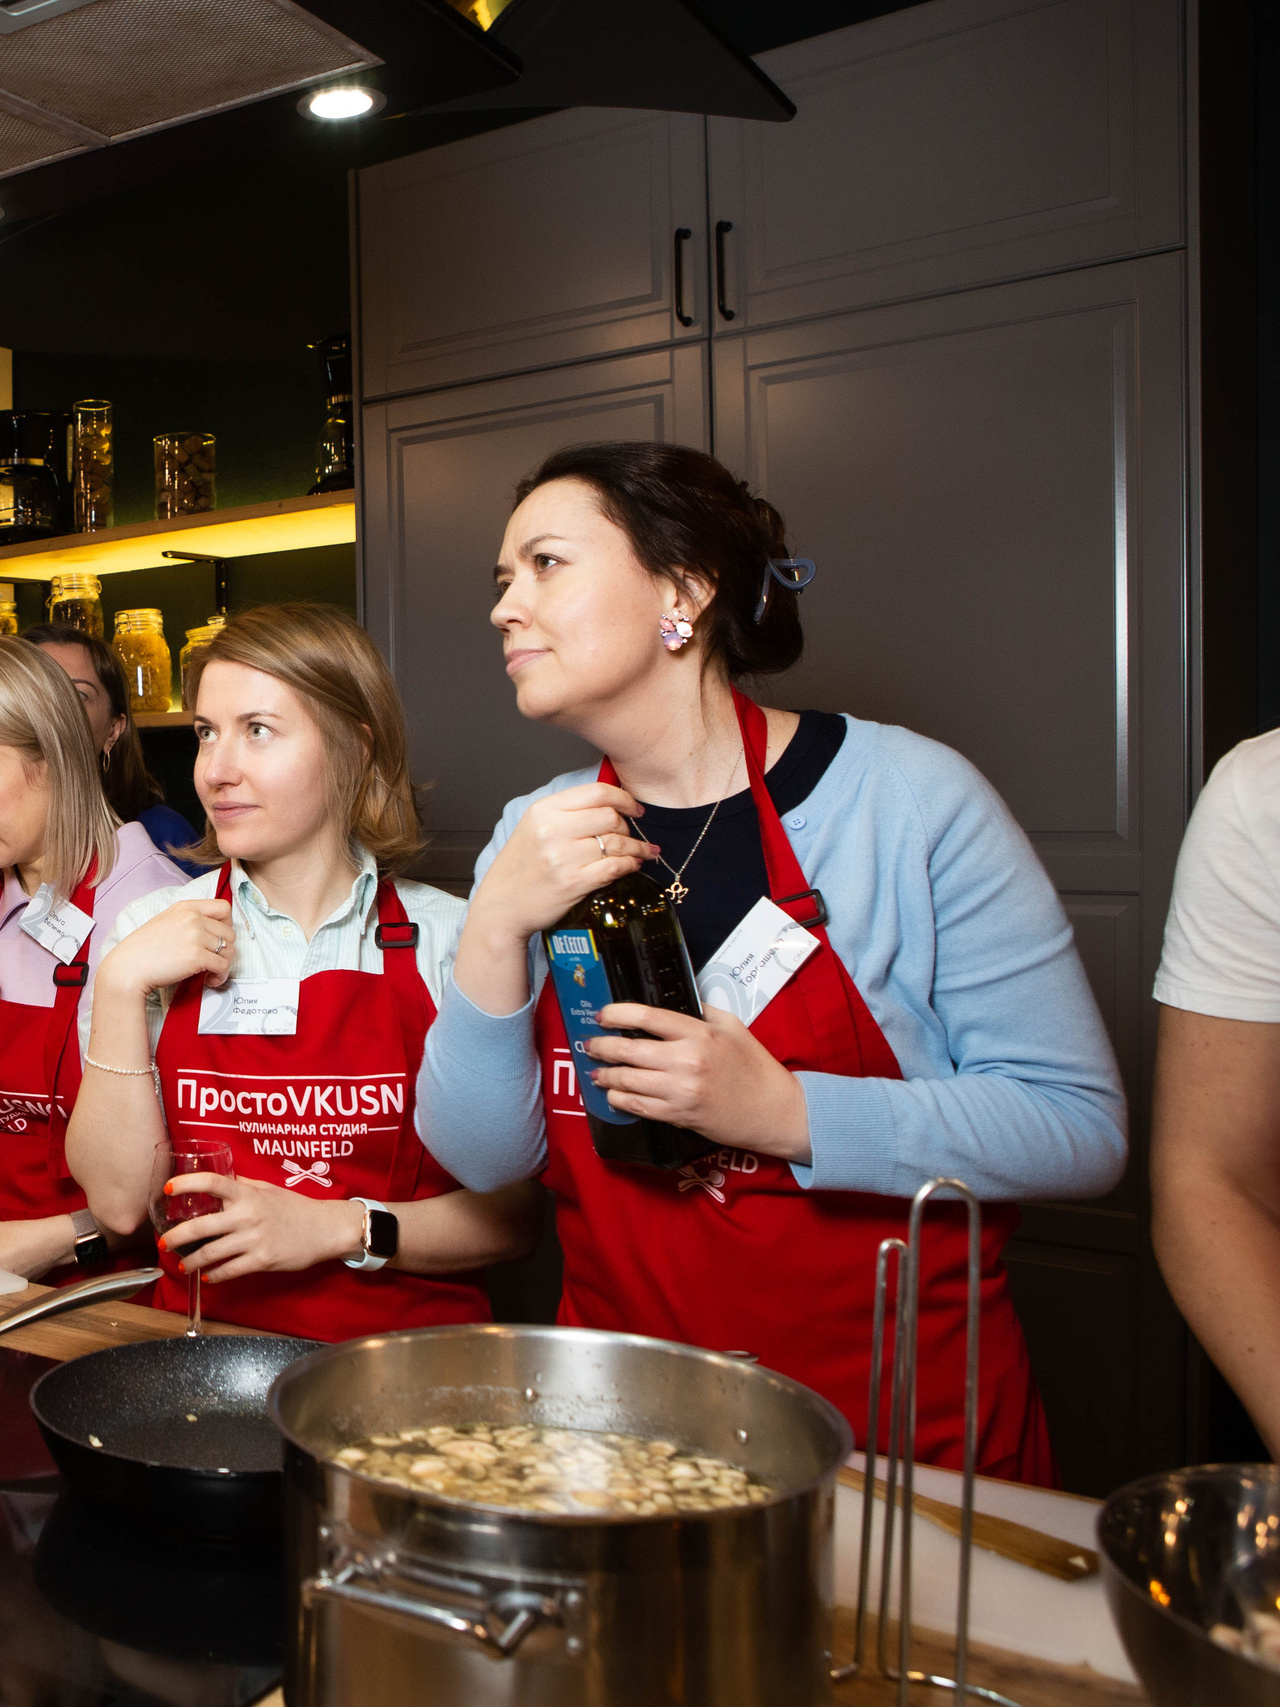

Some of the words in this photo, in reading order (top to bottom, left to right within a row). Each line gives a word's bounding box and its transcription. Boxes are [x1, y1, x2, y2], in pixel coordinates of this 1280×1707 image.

[729, 953, 755, 980] Юлия
[233, 996, 258, 1005] Юлия
[232, 1007, 278, 1016] Федотова
[239, 1121, 317, 1136] КУЛИНАРНАЯ
[319, 1123, 368, 1137] СТУДИЯ
[253, 1138, 354, 1158] MAUNFELD
